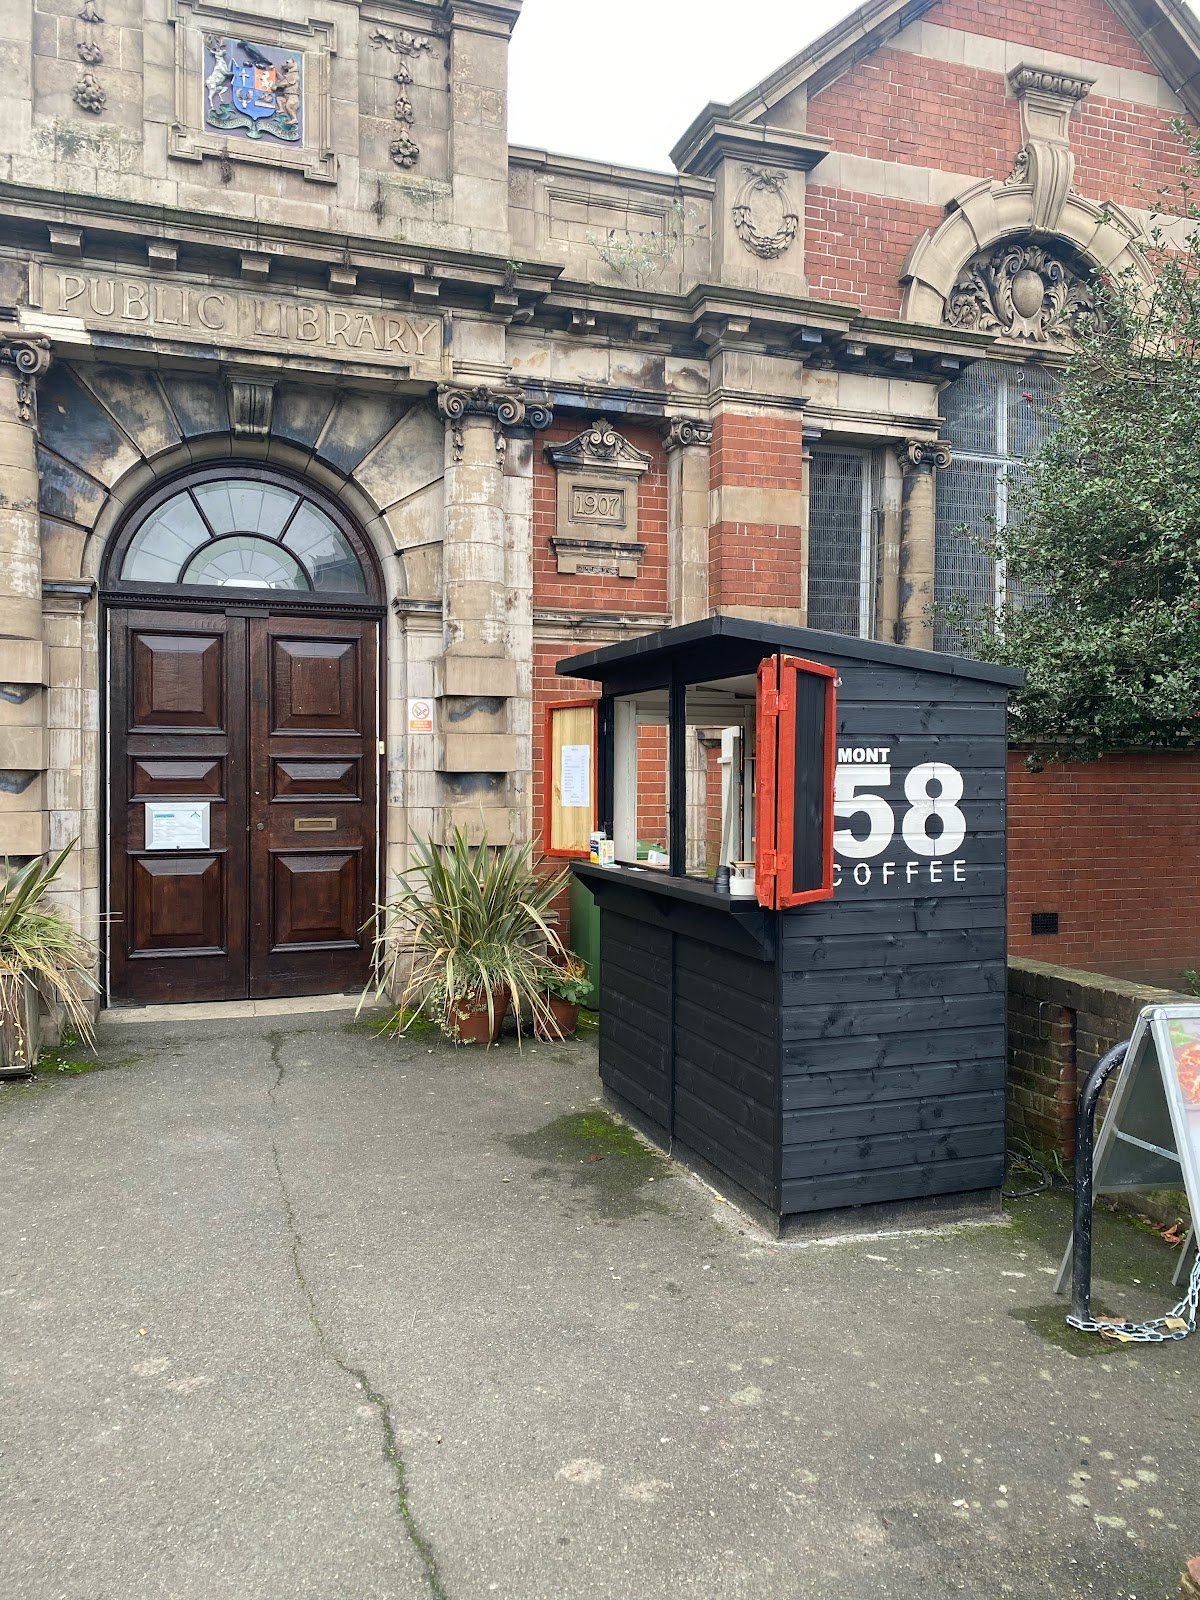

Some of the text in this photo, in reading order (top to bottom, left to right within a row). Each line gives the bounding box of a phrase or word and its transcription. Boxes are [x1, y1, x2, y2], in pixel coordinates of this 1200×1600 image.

[55, 273, 438, 356] PUBLIC LIBRARY
[576, 496, 619, 516] 1907
[837, 747, 891, 763] MONT
[832, 762, 967, 859] 58
[832, 859, 967, 887] COFFEE
